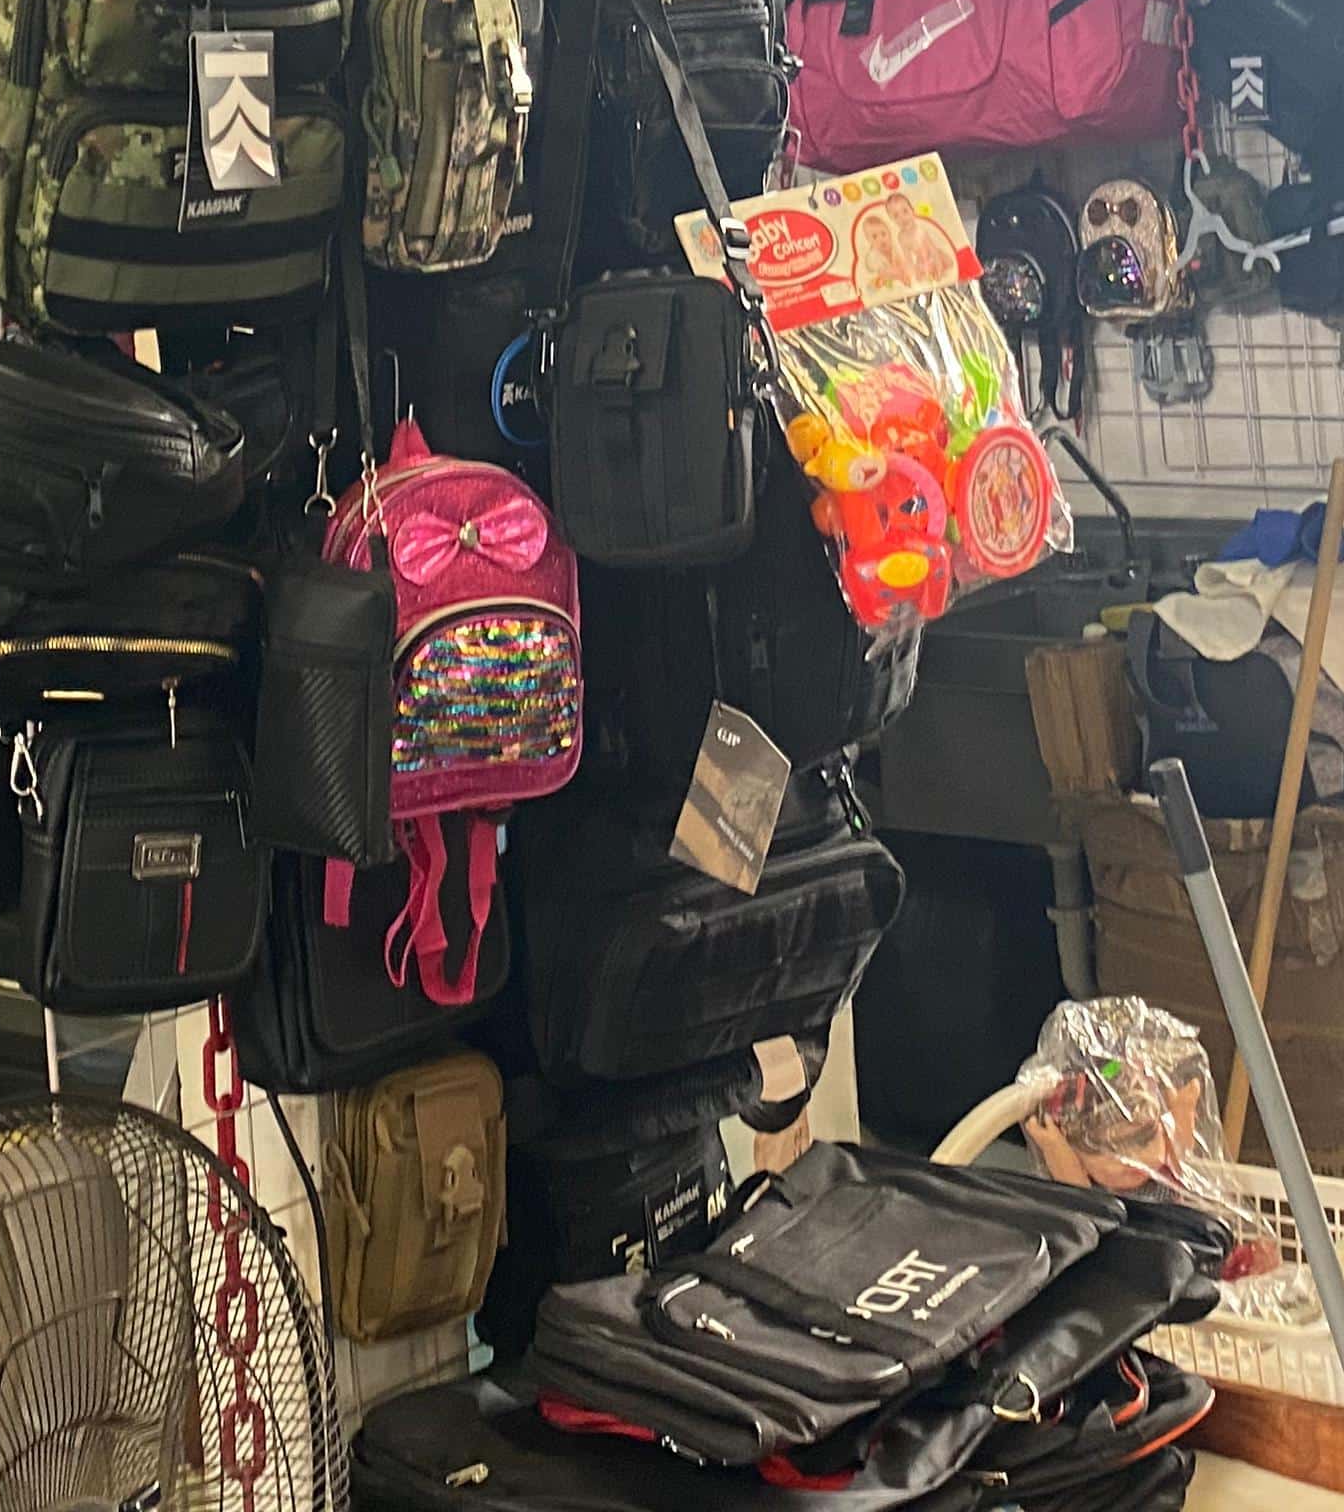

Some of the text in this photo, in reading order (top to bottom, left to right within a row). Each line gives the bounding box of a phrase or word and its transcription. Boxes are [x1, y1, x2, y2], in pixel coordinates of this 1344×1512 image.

[186, 193, 243, 219] KAMPAK
[654, 1182, 700, 1226] KAMPAK
[846, 1249, 947, 1320] ORT
